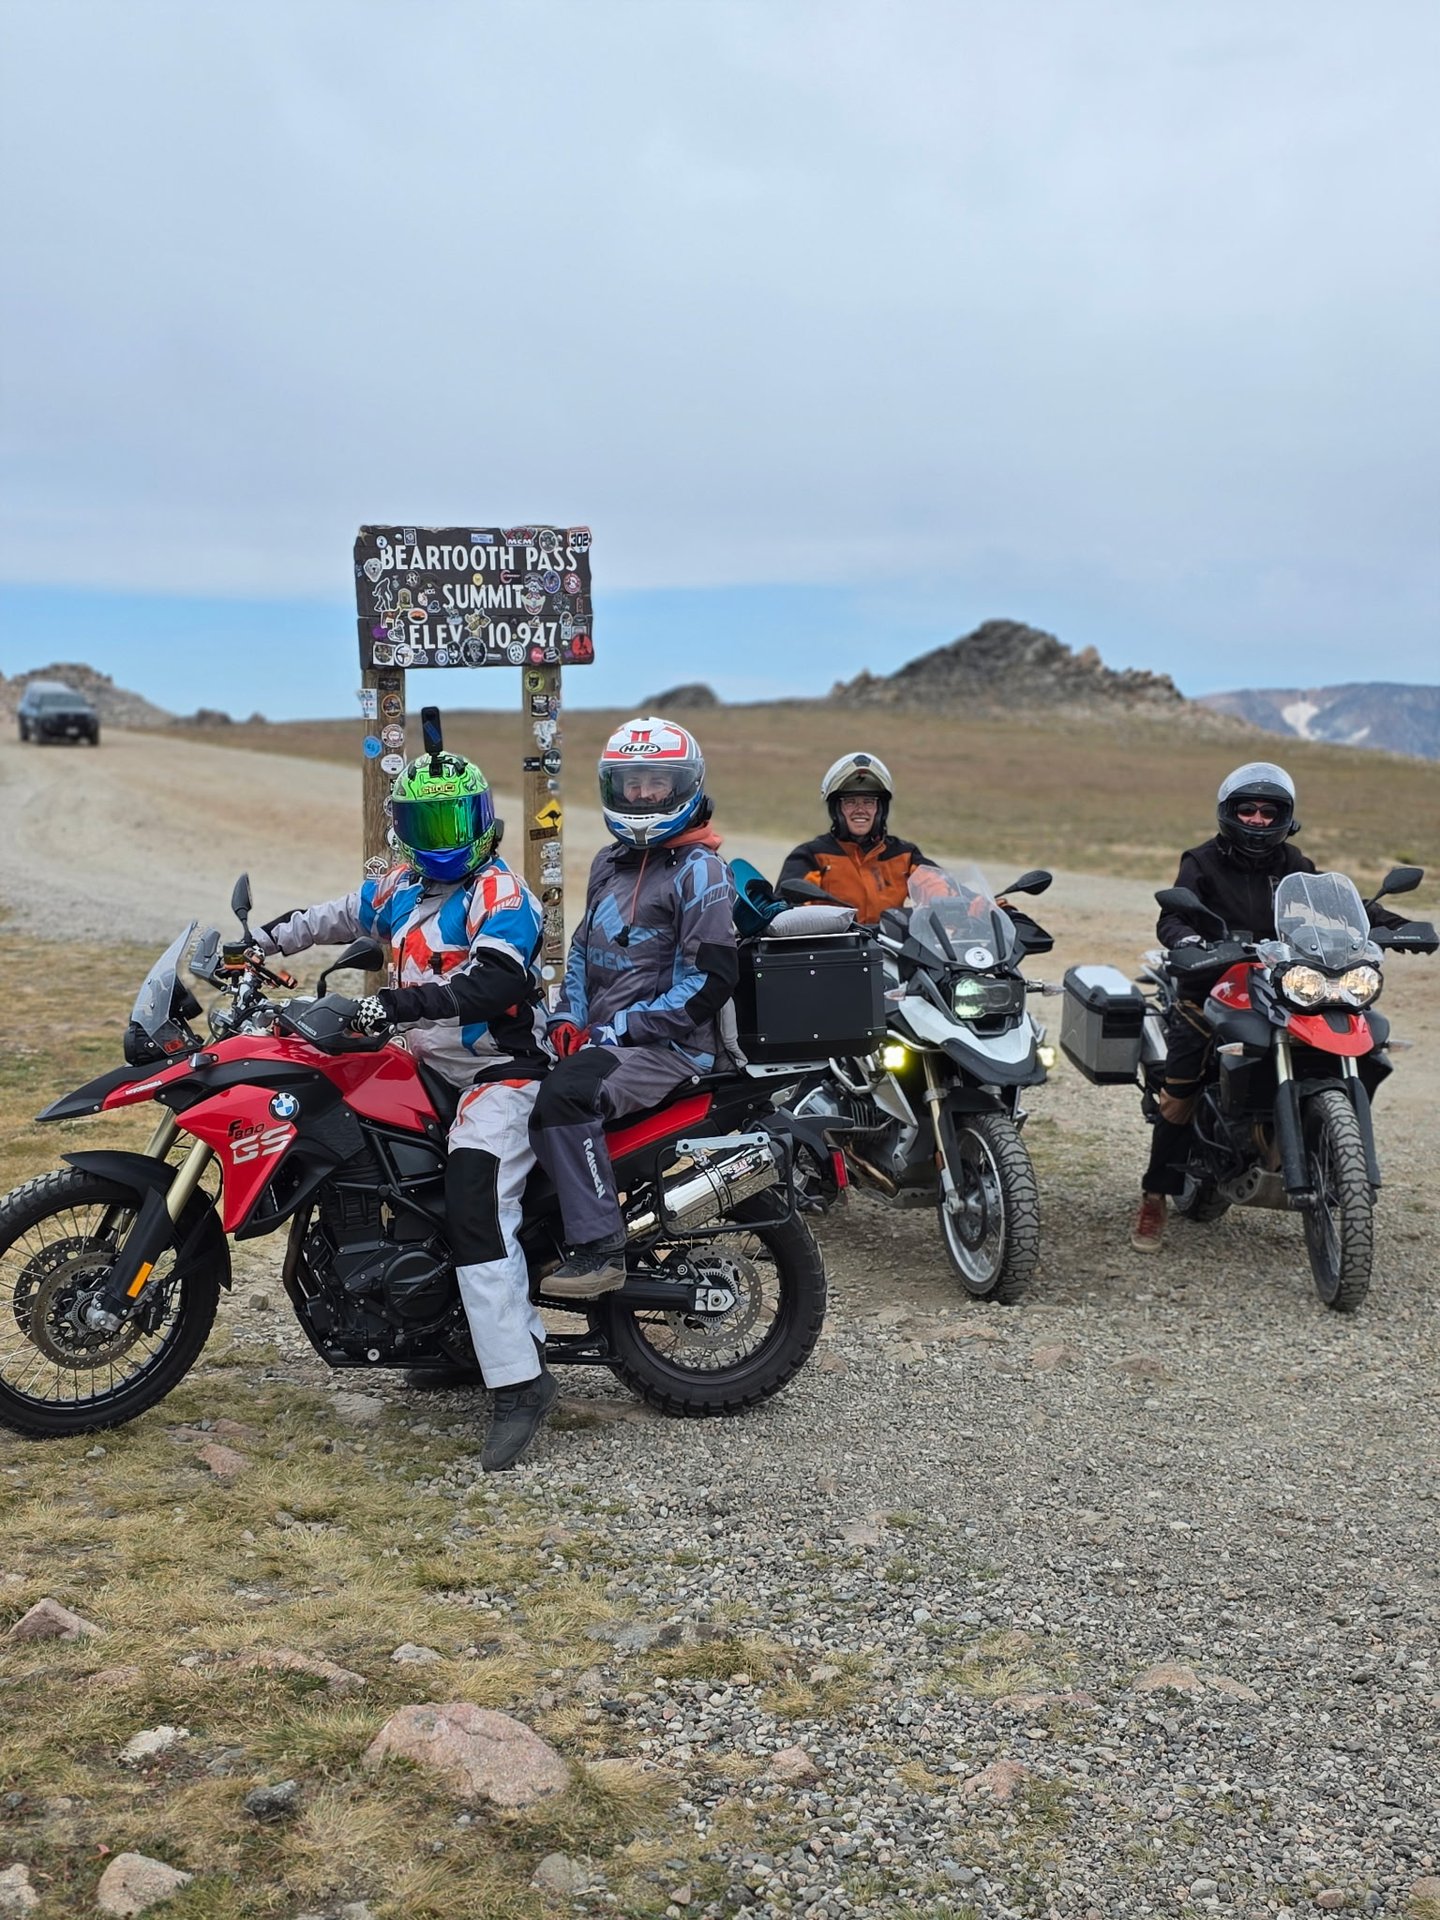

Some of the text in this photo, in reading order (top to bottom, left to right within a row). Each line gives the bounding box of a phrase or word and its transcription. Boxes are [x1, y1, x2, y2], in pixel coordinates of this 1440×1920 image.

[570, 533, 589, 547] 302
[380, 544, 515, 571] BEARTOOTH
[525, 545, 578, 571] PASS
[442, 583, 524, 609] SUMMIT
[409, 621, 558, 650] ELEV 10947
[623, 744, 656, 753] HJC
[229, 1122, 293, 1165] GS
[582, 1137, 606, 1199] RAIDEN
